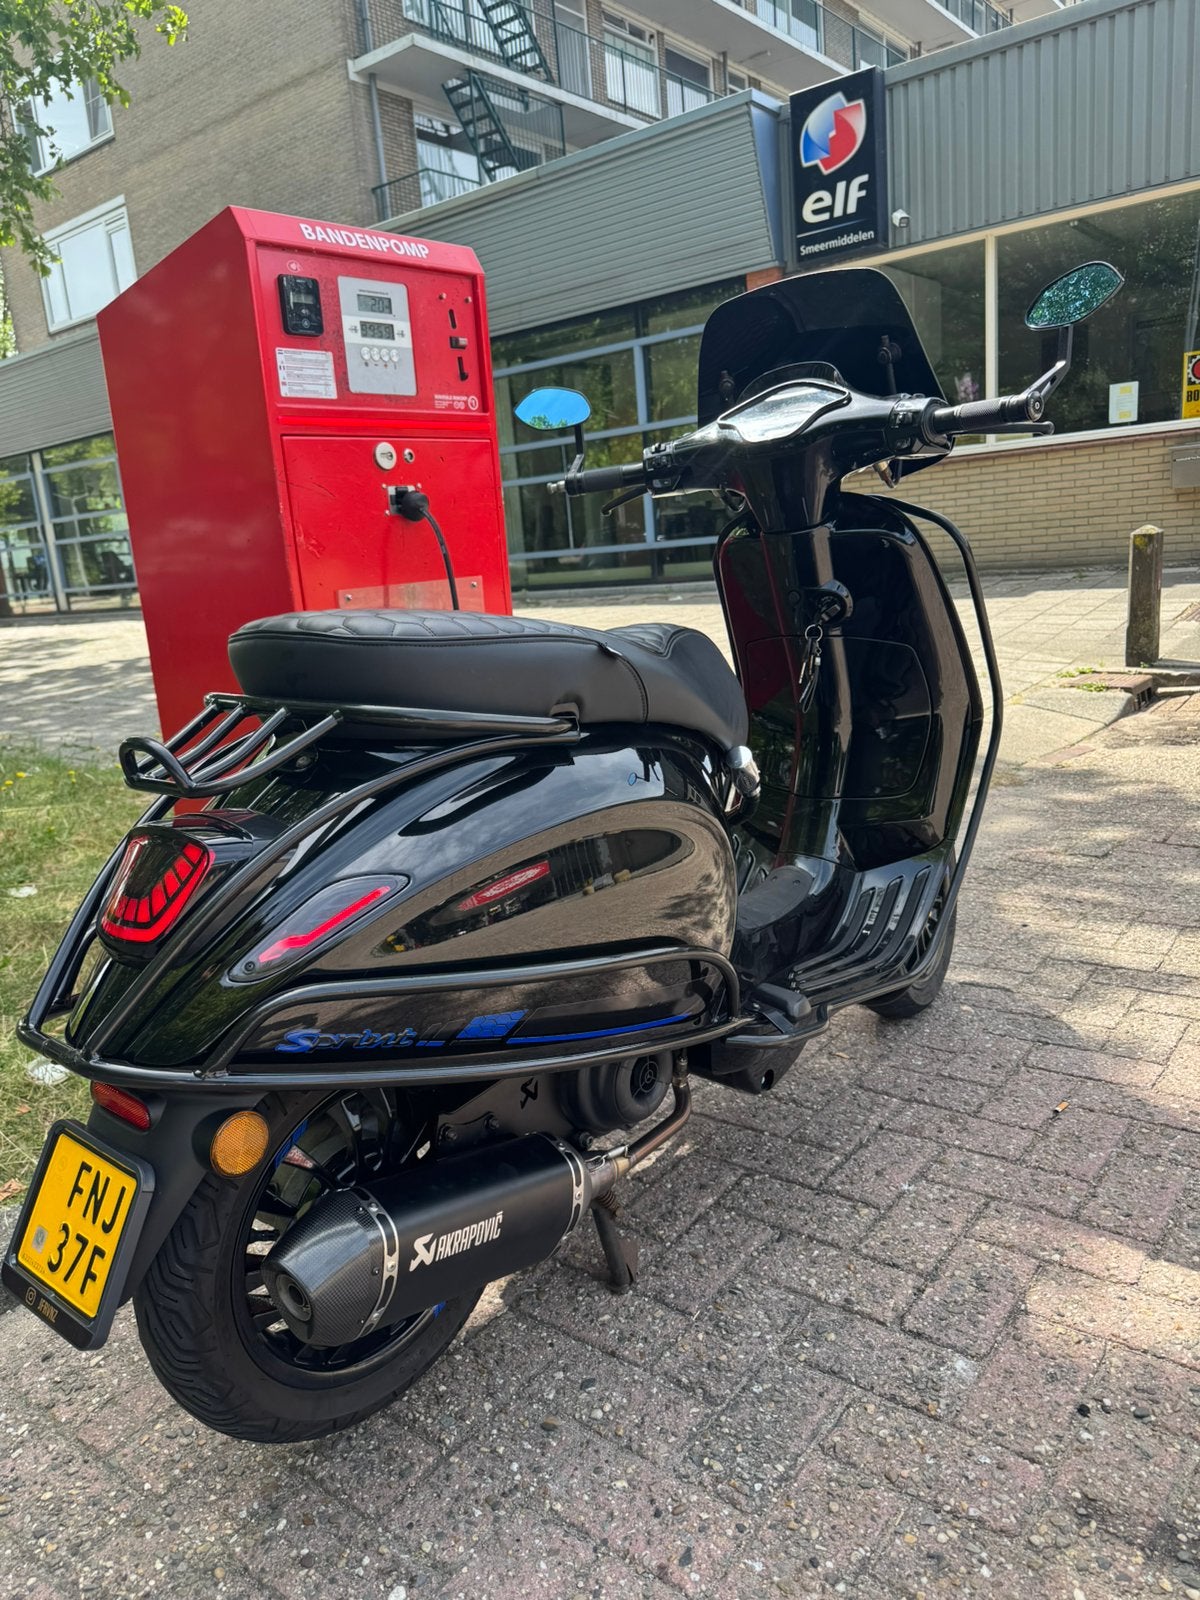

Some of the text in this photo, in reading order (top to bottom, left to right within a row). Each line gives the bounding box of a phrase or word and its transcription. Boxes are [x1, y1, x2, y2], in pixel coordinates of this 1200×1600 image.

[802, 173, 869, 224] elf
[299, 223, 429, 259] BANDENPOMP
[800, 229, 874, 256] Smeermiddelen
[275, 1027, 417, 1054] Sprint
[67, 1160, 127, 1235] FNJ
[47, 1222, 107, 1295] 37F
[435, 1210, 503, 1262] AKRAPOVIČ
